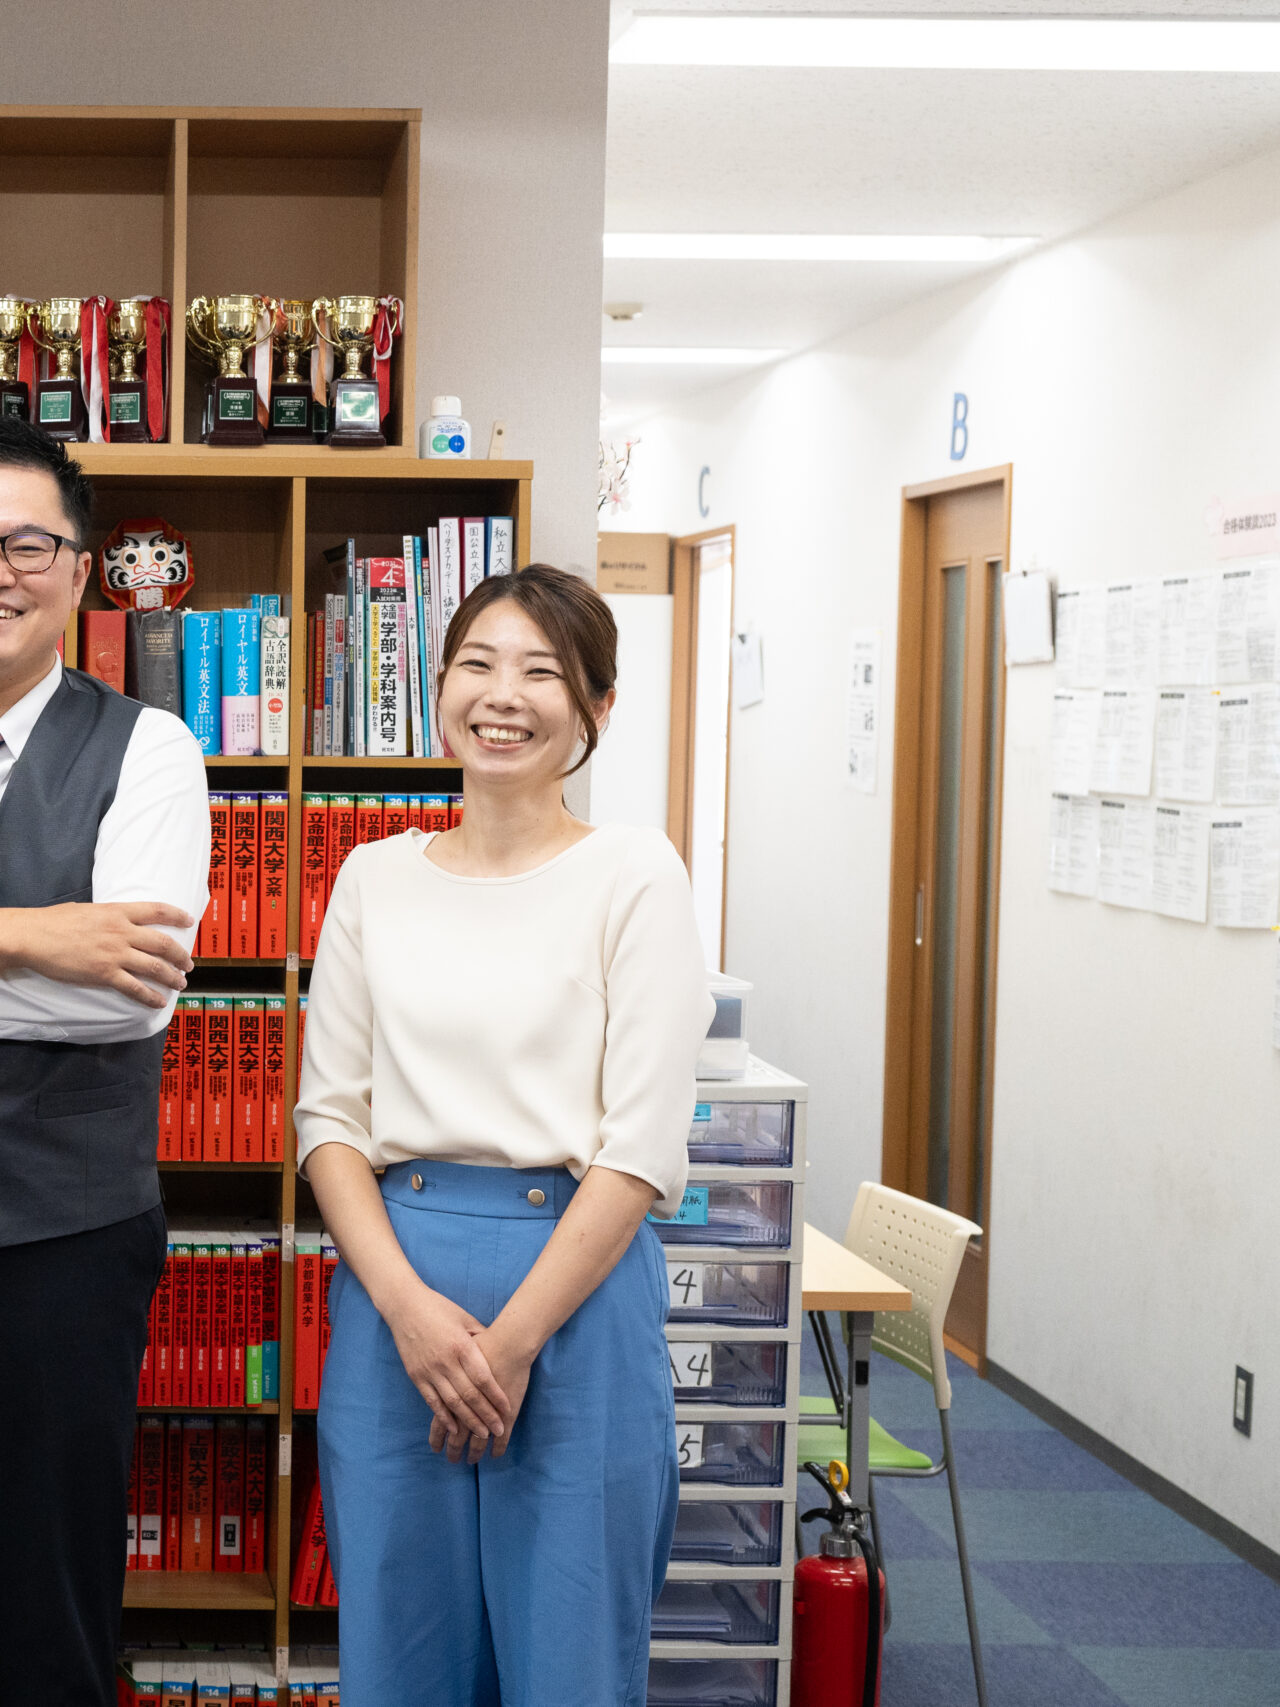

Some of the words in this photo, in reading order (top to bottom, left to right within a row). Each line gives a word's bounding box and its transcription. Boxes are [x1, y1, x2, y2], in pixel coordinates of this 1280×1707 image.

[949, 392, 969, 461] B
[698, 466, 710, 518] C
[380, 568, 396, 586] 4
[381, 604, 389, 620] 大学
[388, 604, 397, 620] 全国
[198, 617, 211, 715] ロイヤル英文法
[236, 614, 249, 696] ロイヤル英文
[264, 640, 275, 690] 古語辞典
[275, 640, 287, 690] 全訳読解
[380, 621, 397, 743] 学部・学科案内号
[210, 811, 227, 869] 関西大学
[234, 811, 256, 869] 関西大学
[264, 811, 285, 874] 関西大学
[306, 812, 325, 870] 立命館大学
[265, 877, 282, 897] 文系
[185, 1015, 201, 1068] 関西大学
[208, 1015, 229, 1073] 関西大学
[238, 1016, 260, 1073] 関西大学
[267, 1016, 283, 1073] 関西大学
[302, 1258, 314, 1327] 京都産業大学
[672, 1268, 698, 1305] 4
[678, 1432, 701, 1467] 5
